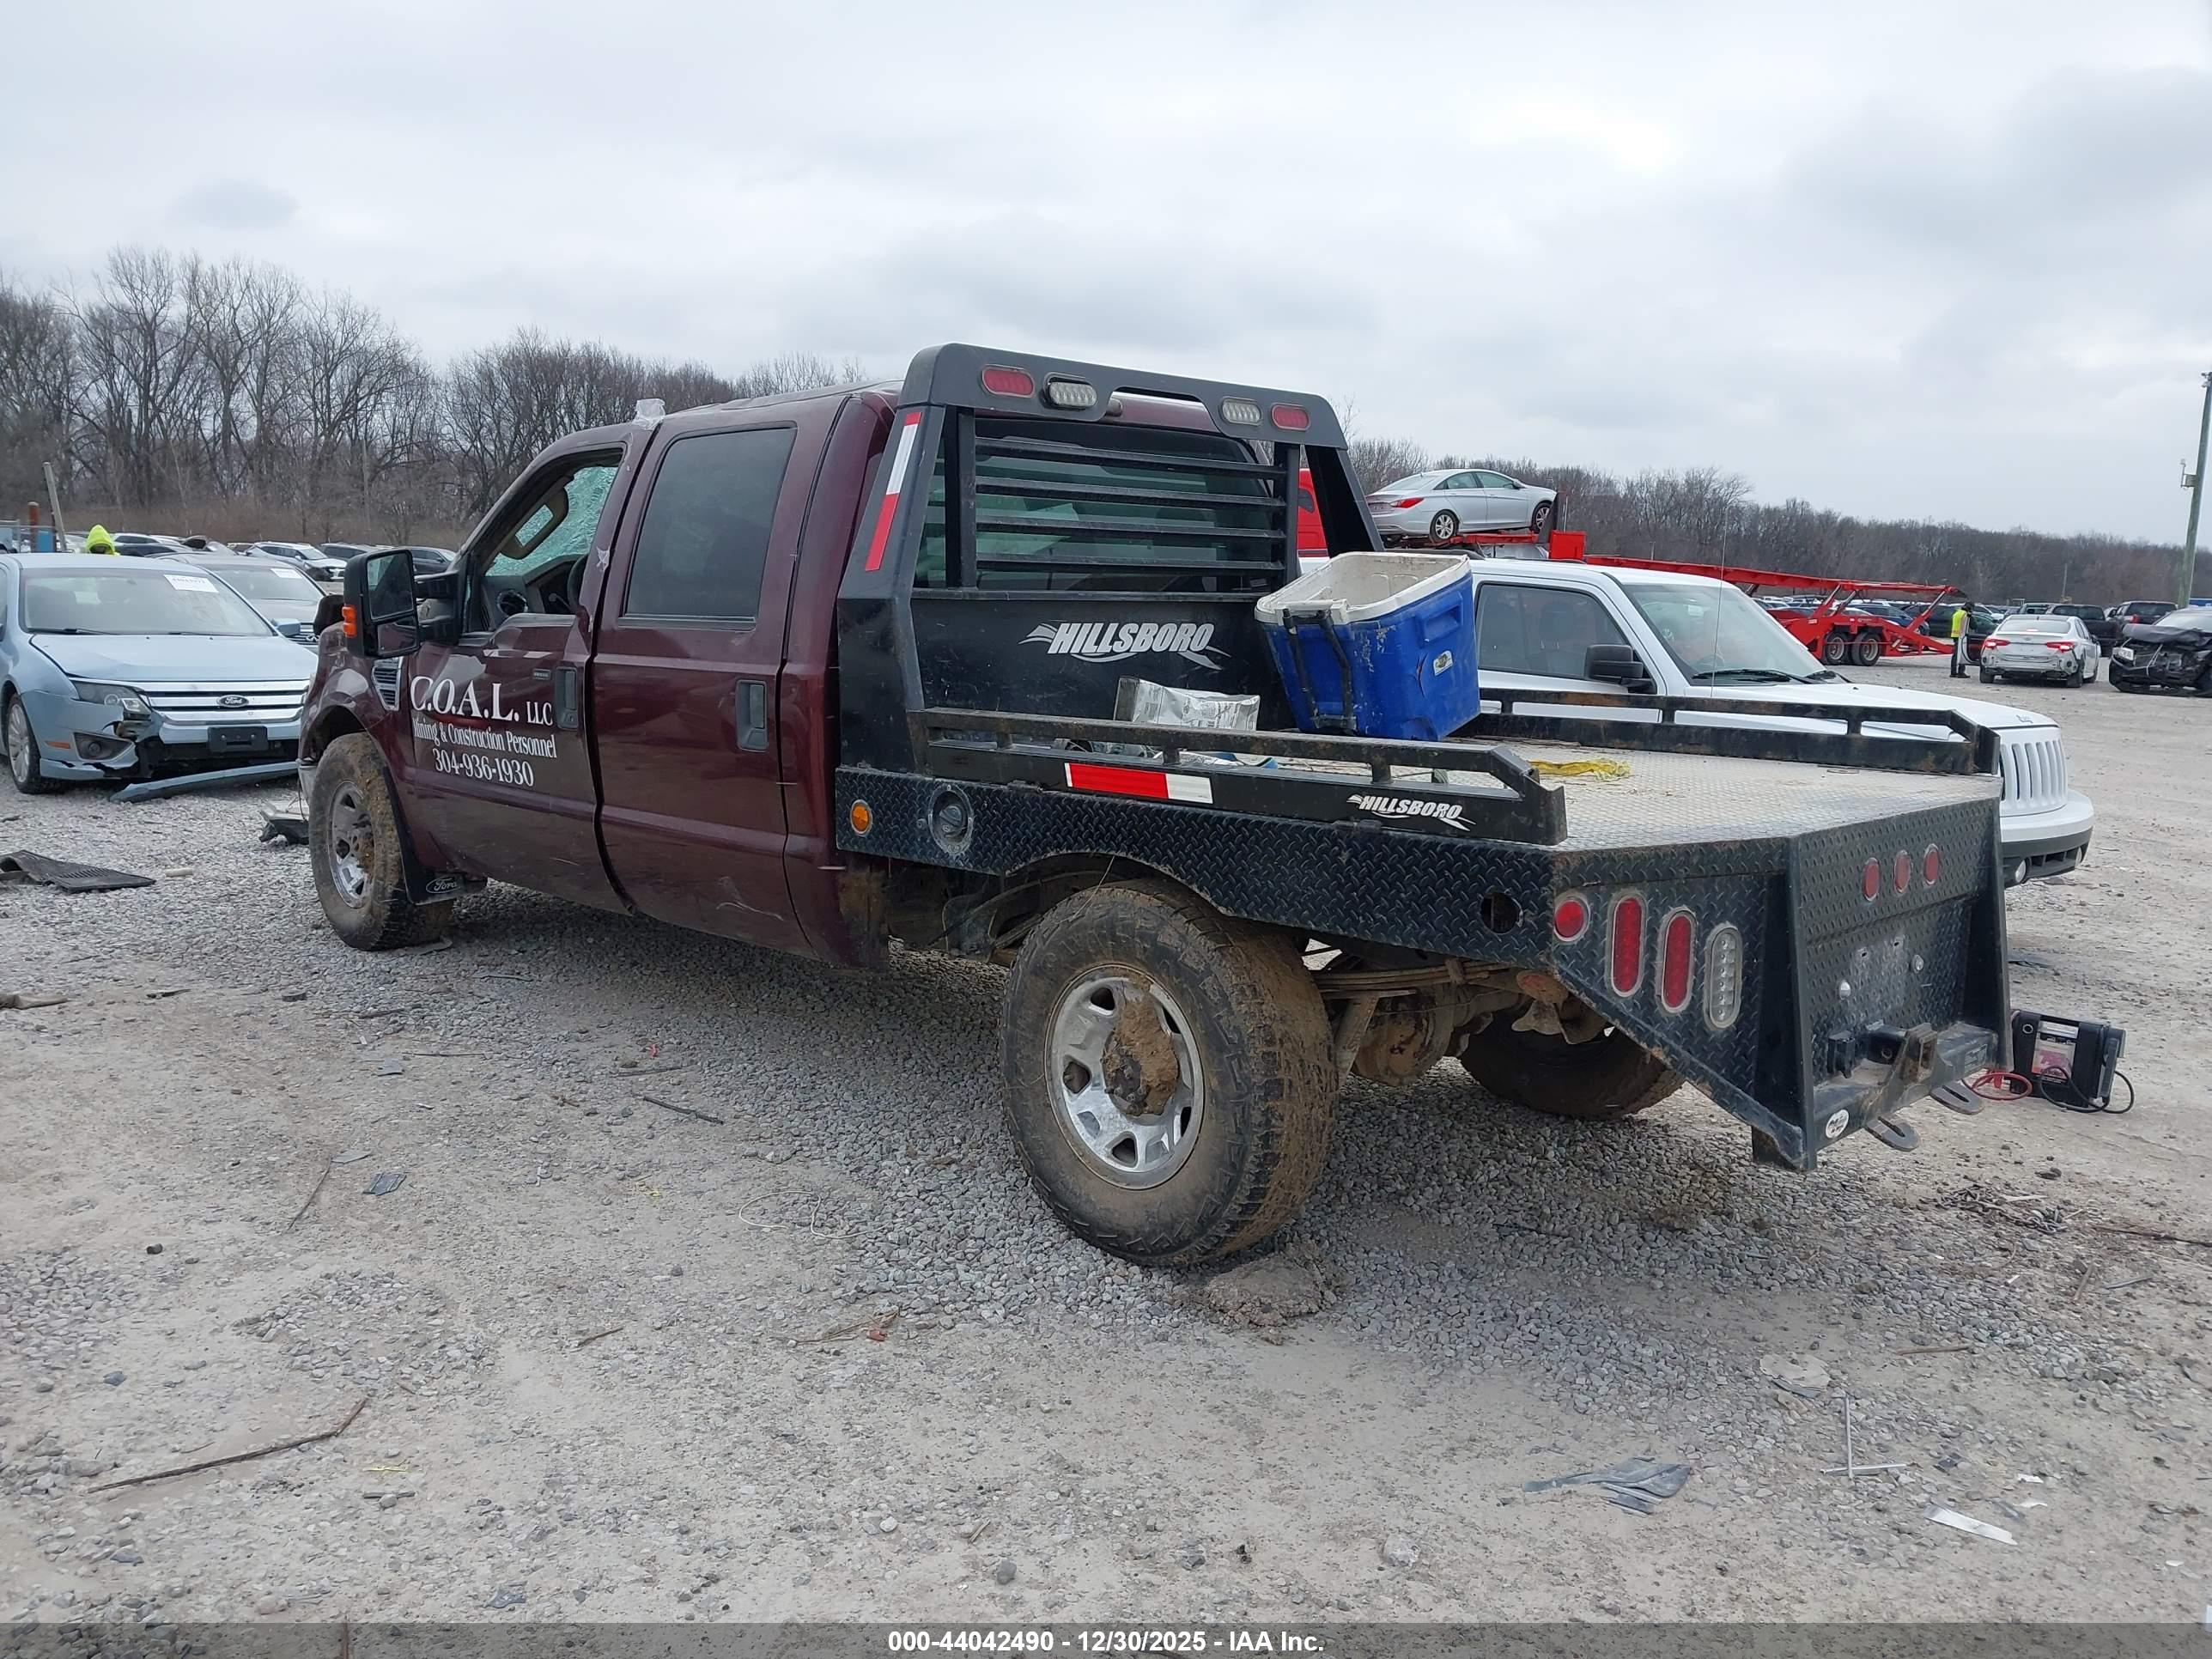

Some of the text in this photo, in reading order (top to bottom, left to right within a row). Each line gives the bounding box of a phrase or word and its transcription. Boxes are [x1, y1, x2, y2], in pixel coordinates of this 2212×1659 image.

[1047, 623, 1215, 654] HILLSBORO
[224, 696, 243, 705] Ford
[410, 676, 552, 726] C.O.A.L. LLC
[413, 717, 557, 758] Mining & Construction Personnel
[432, 748, 534, 787] 304-936-1930
[1359, 795, 1462, 819] HILLSBORO
